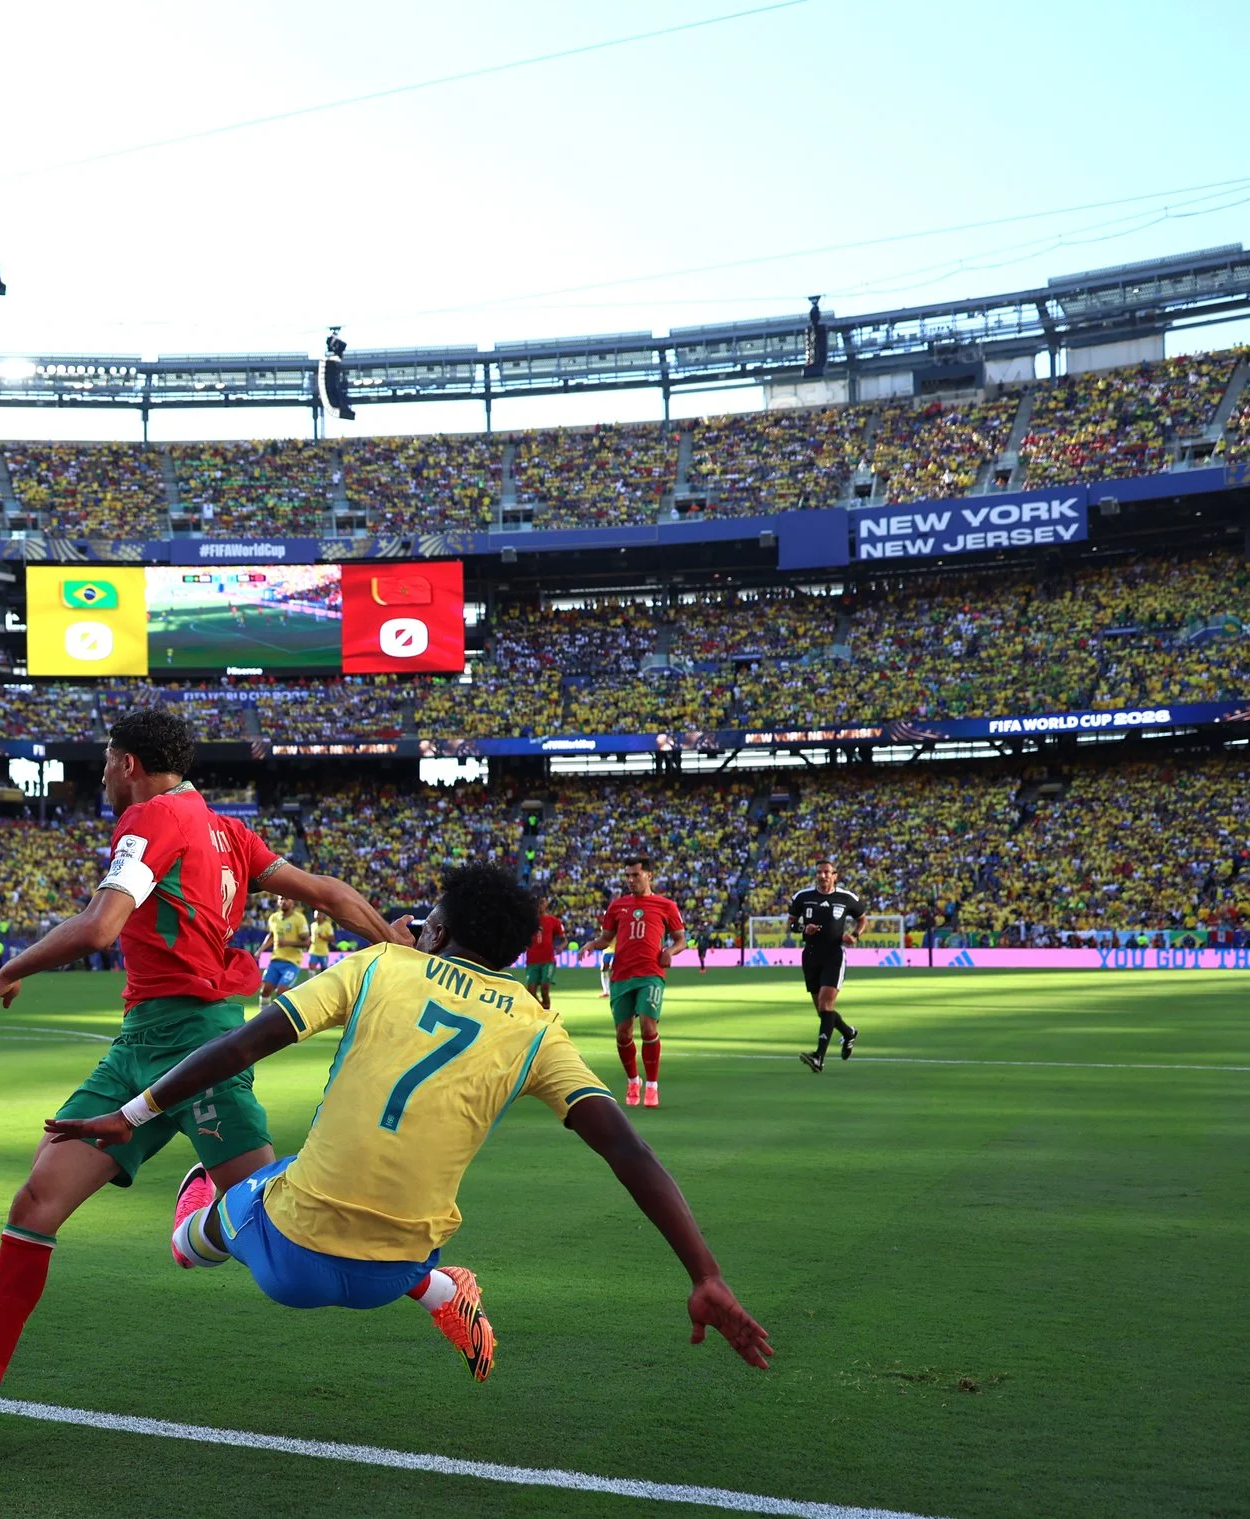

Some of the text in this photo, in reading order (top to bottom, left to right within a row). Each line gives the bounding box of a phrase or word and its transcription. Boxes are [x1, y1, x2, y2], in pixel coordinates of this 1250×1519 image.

[859, 498, 1080, 538] NEW YORK
[199, 543, 286, 559] #FIFAWorldCup
[860, 523, 1079, 559] NEW JERSEY
[65, 621, 114, 660] 0
[380, 618, 429, 658] 0
[745, 728, 882, 744] NEW YORK NEW JERSEY
[989, 710, 1171, 733] FIFA WORLD CUP 2026
[629, 921, 646, 939] 10
[1097, 948, 1250, 968] YOU GOT TH
[425, 957, 515, 1018] VINI JR.
[647, 985, 662, 1005] 10
[379, 999, 483, 1133] 7
